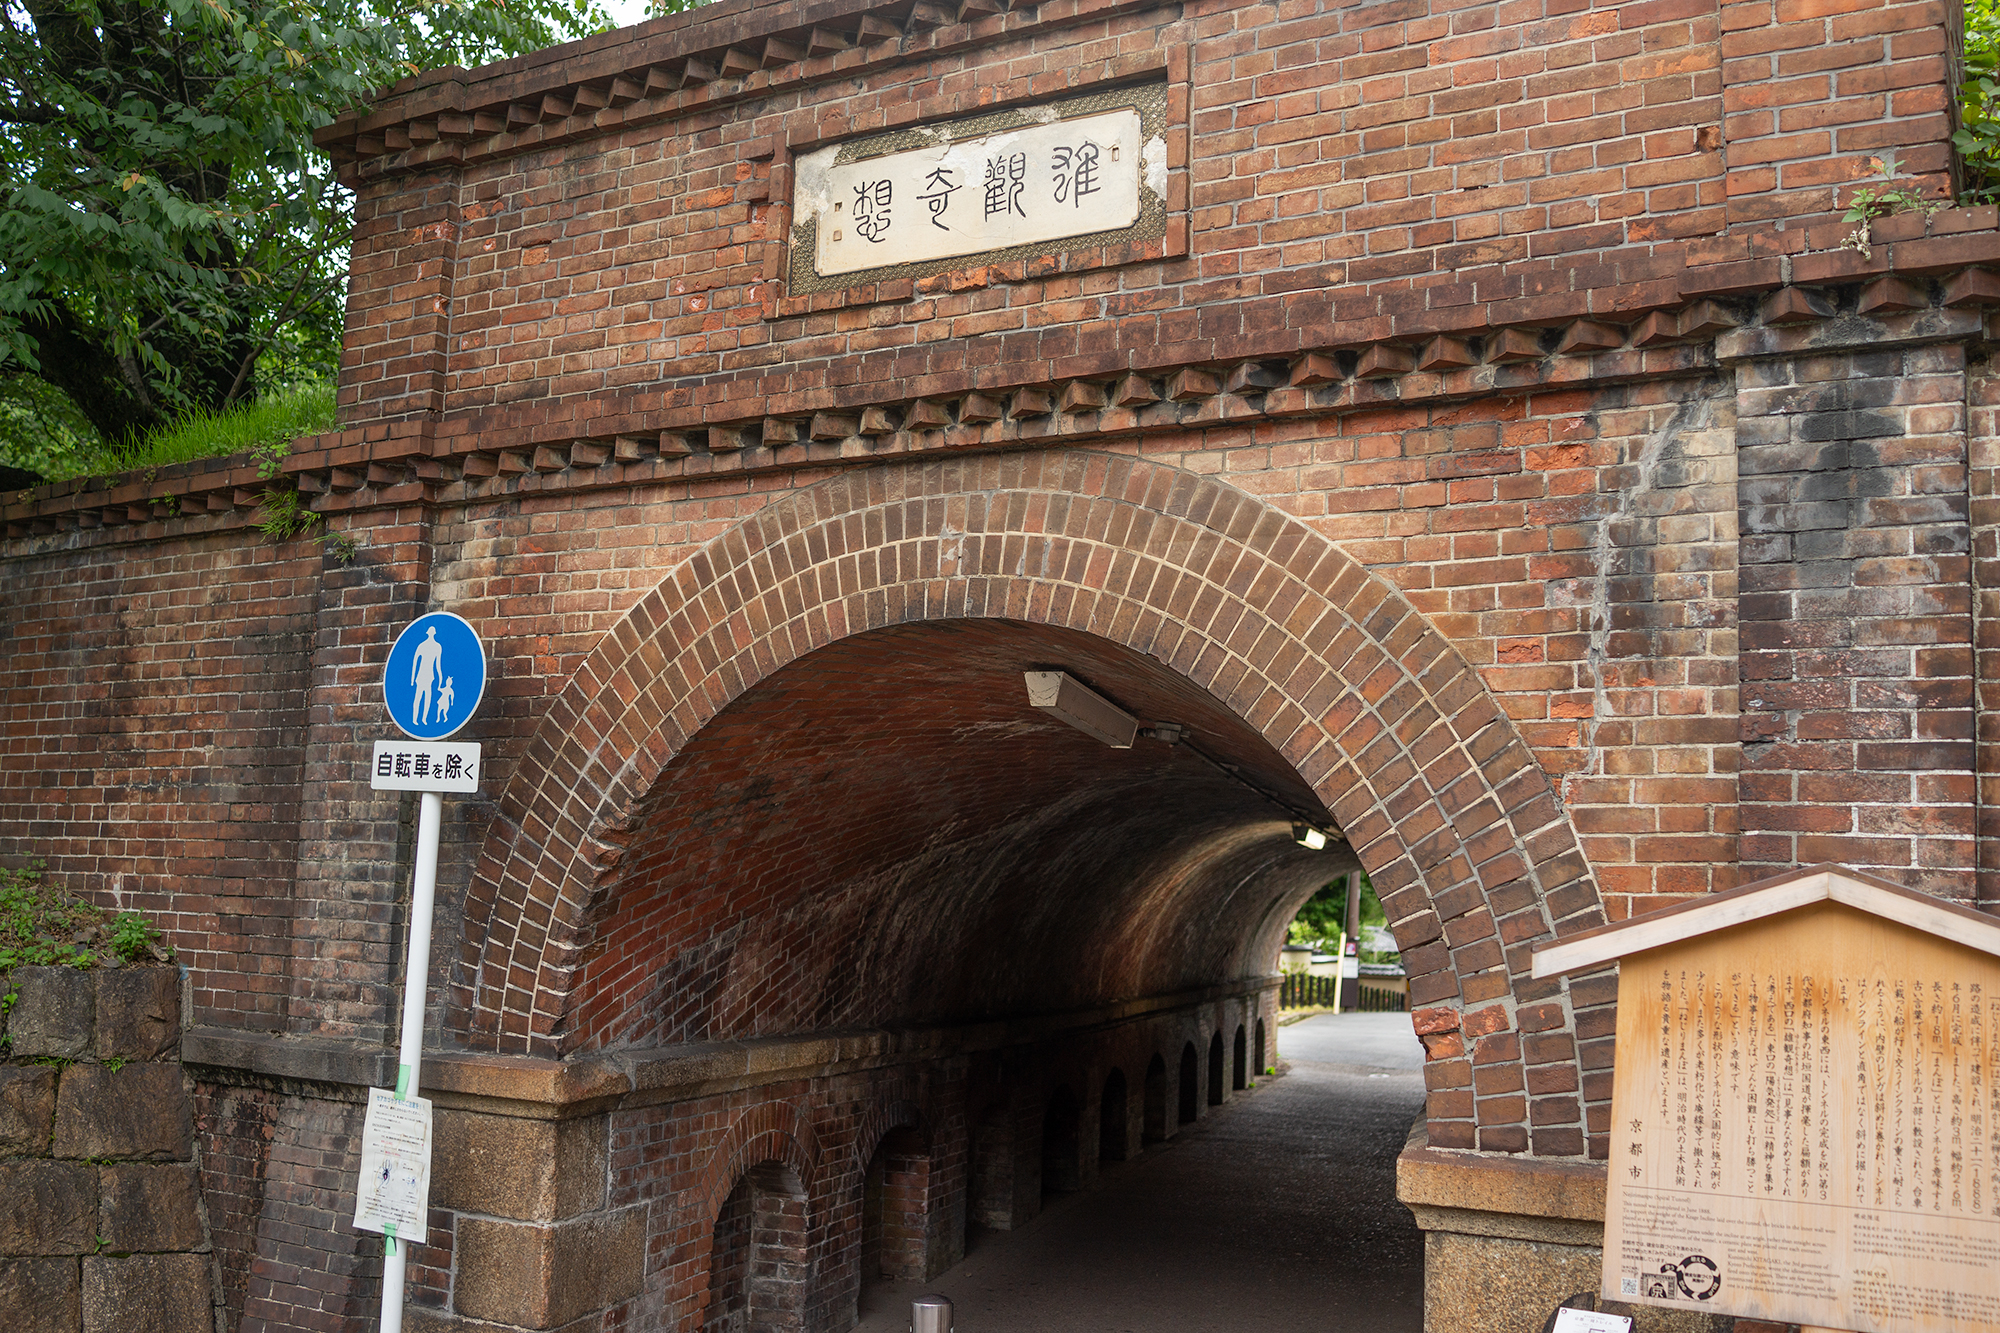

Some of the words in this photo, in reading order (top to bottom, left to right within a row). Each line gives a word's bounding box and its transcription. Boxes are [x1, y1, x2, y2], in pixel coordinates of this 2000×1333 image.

[377, 752, 474, 780] 自転車を除く
[1838, 978, 1850, 1013] います。
[1660, 969, 1672, 1125] を物語る貴重な遺産といえます。
[1728, 973, 1742, 1100] ができる」という意味です。
[1628, 1118, 1642, 1180] 京都市
[1652, 1285, 1664, 1297] 京
